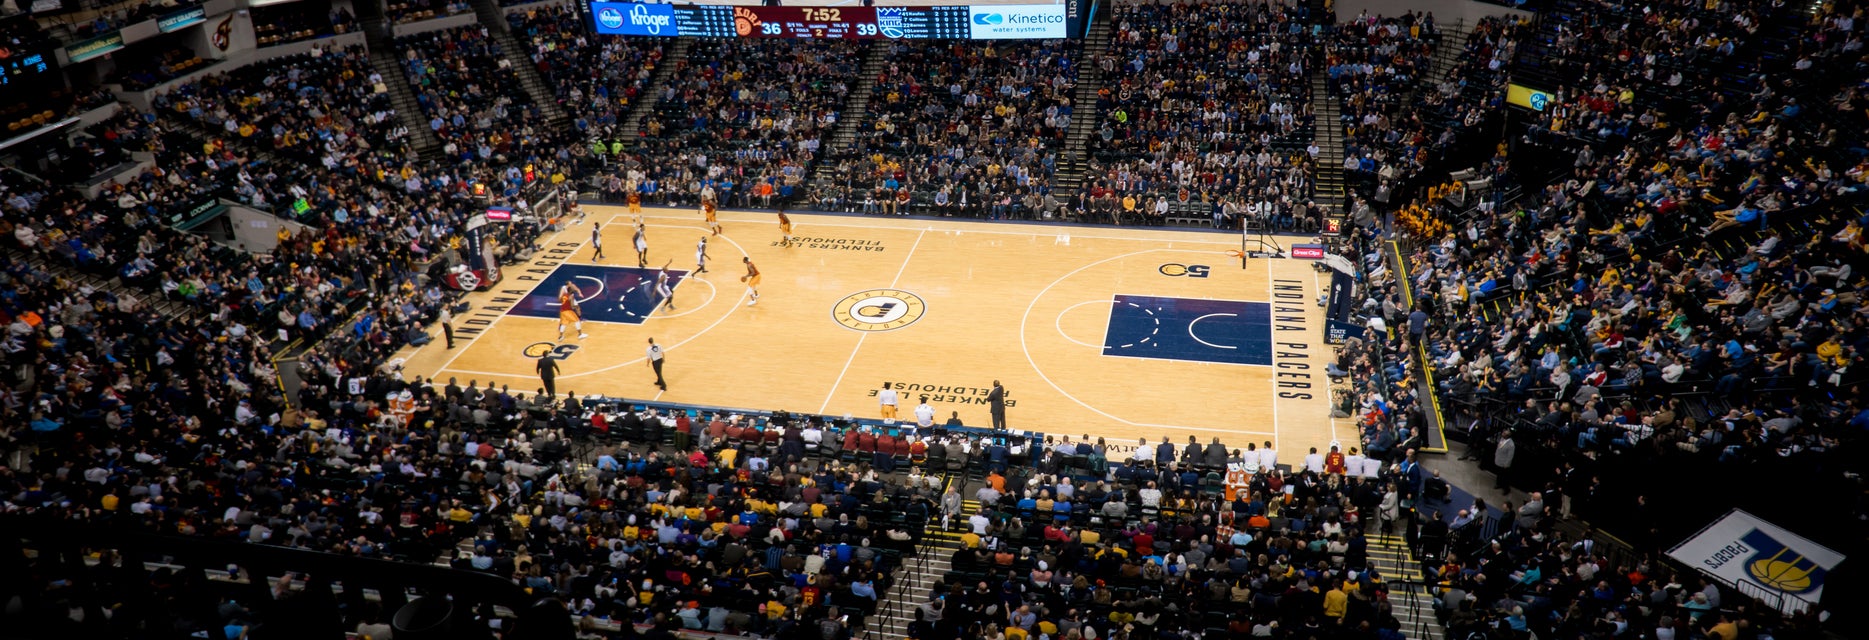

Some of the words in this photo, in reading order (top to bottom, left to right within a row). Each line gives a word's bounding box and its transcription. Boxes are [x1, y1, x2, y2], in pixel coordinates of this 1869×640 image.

[802, 8, 841, 21] 7:52
[1068, 0, 1078, 18] ent
[629, 4, 670, 35] Kroger
[734, 6, 762, 26] KORY
[1008, 13, 1063, 24] Kinetico
[762, 22, 782, 35] 36
[816, 28, 823, 37] 2
[856, 23, 878, 36] 39
[770, 241, 803, 249] LFE
[783, 236, 881, 246] FIELDHOUS
[809, 243, 885, 252] BANKERS
[452, 289, 527, 340] INDIANA
[516, 241, 580, 281] PACERS
[1274, 279, 1306, 331] INDIANA
[1276, 342, 1313, 400] PACERS
[868, 389, 910, 399] LE
[882, 382, 1010, 397] FELDHOUS
[919, 393, 1017, 407] BNKERS
